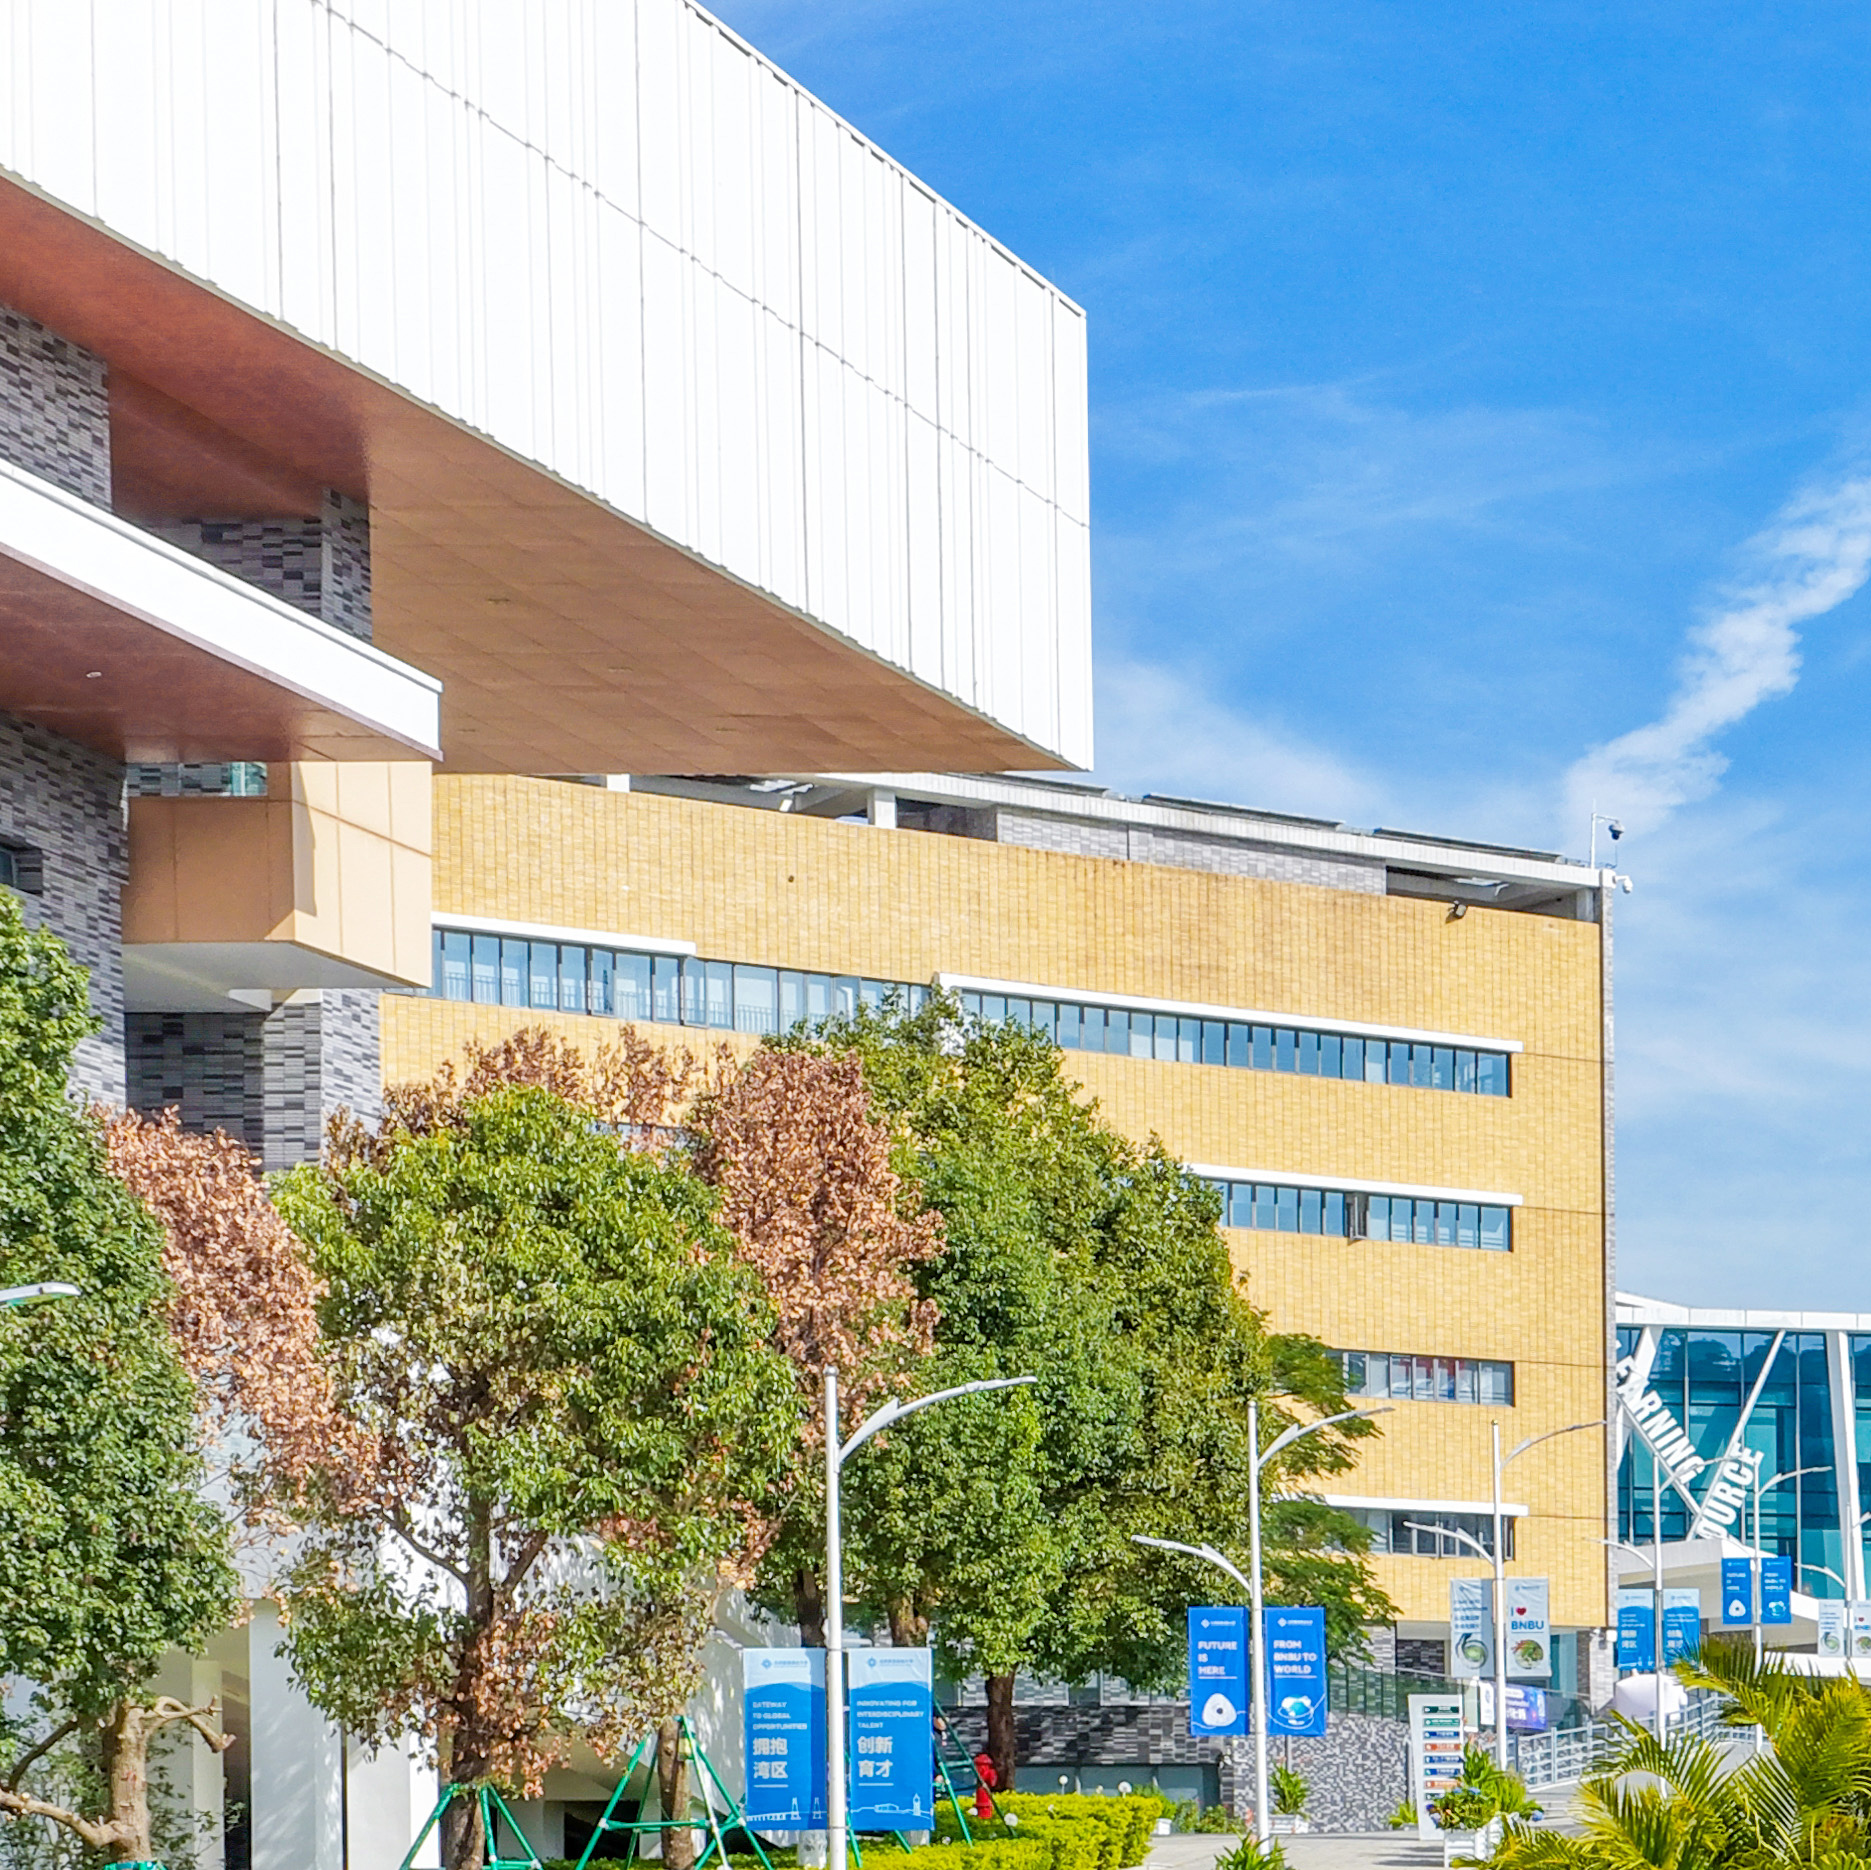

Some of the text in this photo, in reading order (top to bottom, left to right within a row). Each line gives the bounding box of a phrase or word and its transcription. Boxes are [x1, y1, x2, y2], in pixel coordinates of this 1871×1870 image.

[1616, 1342, 1705, 1484] EARNING
[1695, 1442, 1764, 1541] OURCE
[1511, 1620, 1545, 1631] BNBU
[1197, 1640, 1238, 1650] FUTURE
[1273, 1640, 1302, 1649] FROM
[1197, 1653, 1209, 1663] IS
[1303, 1652, 1318, 1661] TO
[1197, 1665, 1226, 1675] HERE
[1273, 1665, 1312, 1674] WORLD
[753, 1736, 788, 1756] 拥抱
[857, 1735, 893, 1755] 创新
[753, 1760, 788, 1779] 湾区
[858, 1759, 893, 1778] 育才
